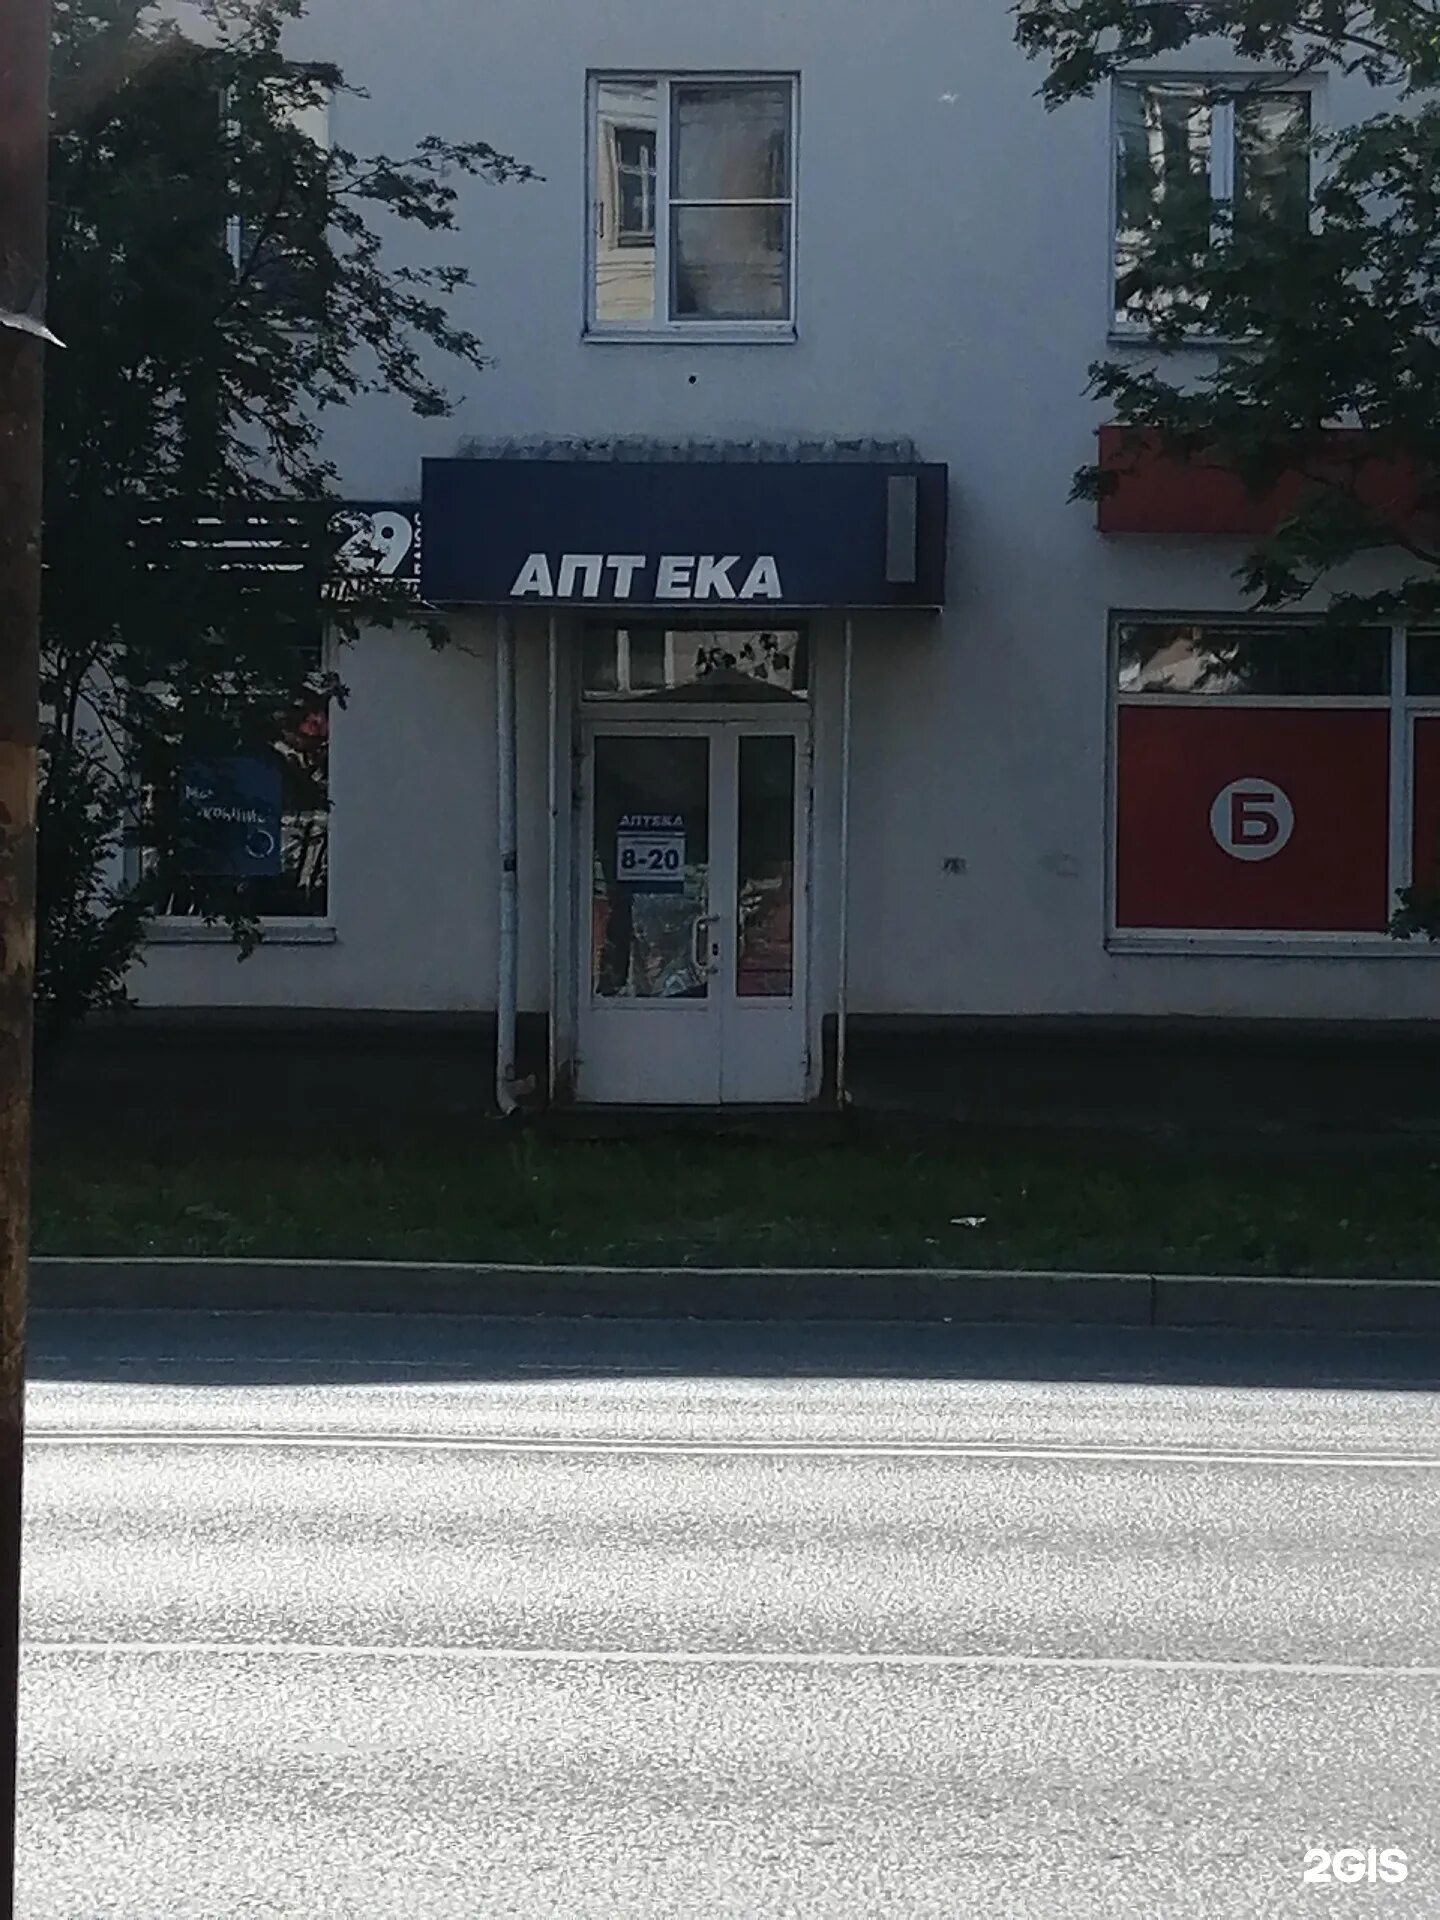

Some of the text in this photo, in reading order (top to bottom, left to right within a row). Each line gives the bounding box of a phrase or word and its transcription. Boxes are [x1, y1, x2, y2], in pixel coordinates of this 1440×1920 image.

[326, 510, 412, 575] 29
[619, 815, 684, 827] АПТЕКА
[1231, 792, 1279, 845] Б
[621, 848, 680, 871] 8-20
